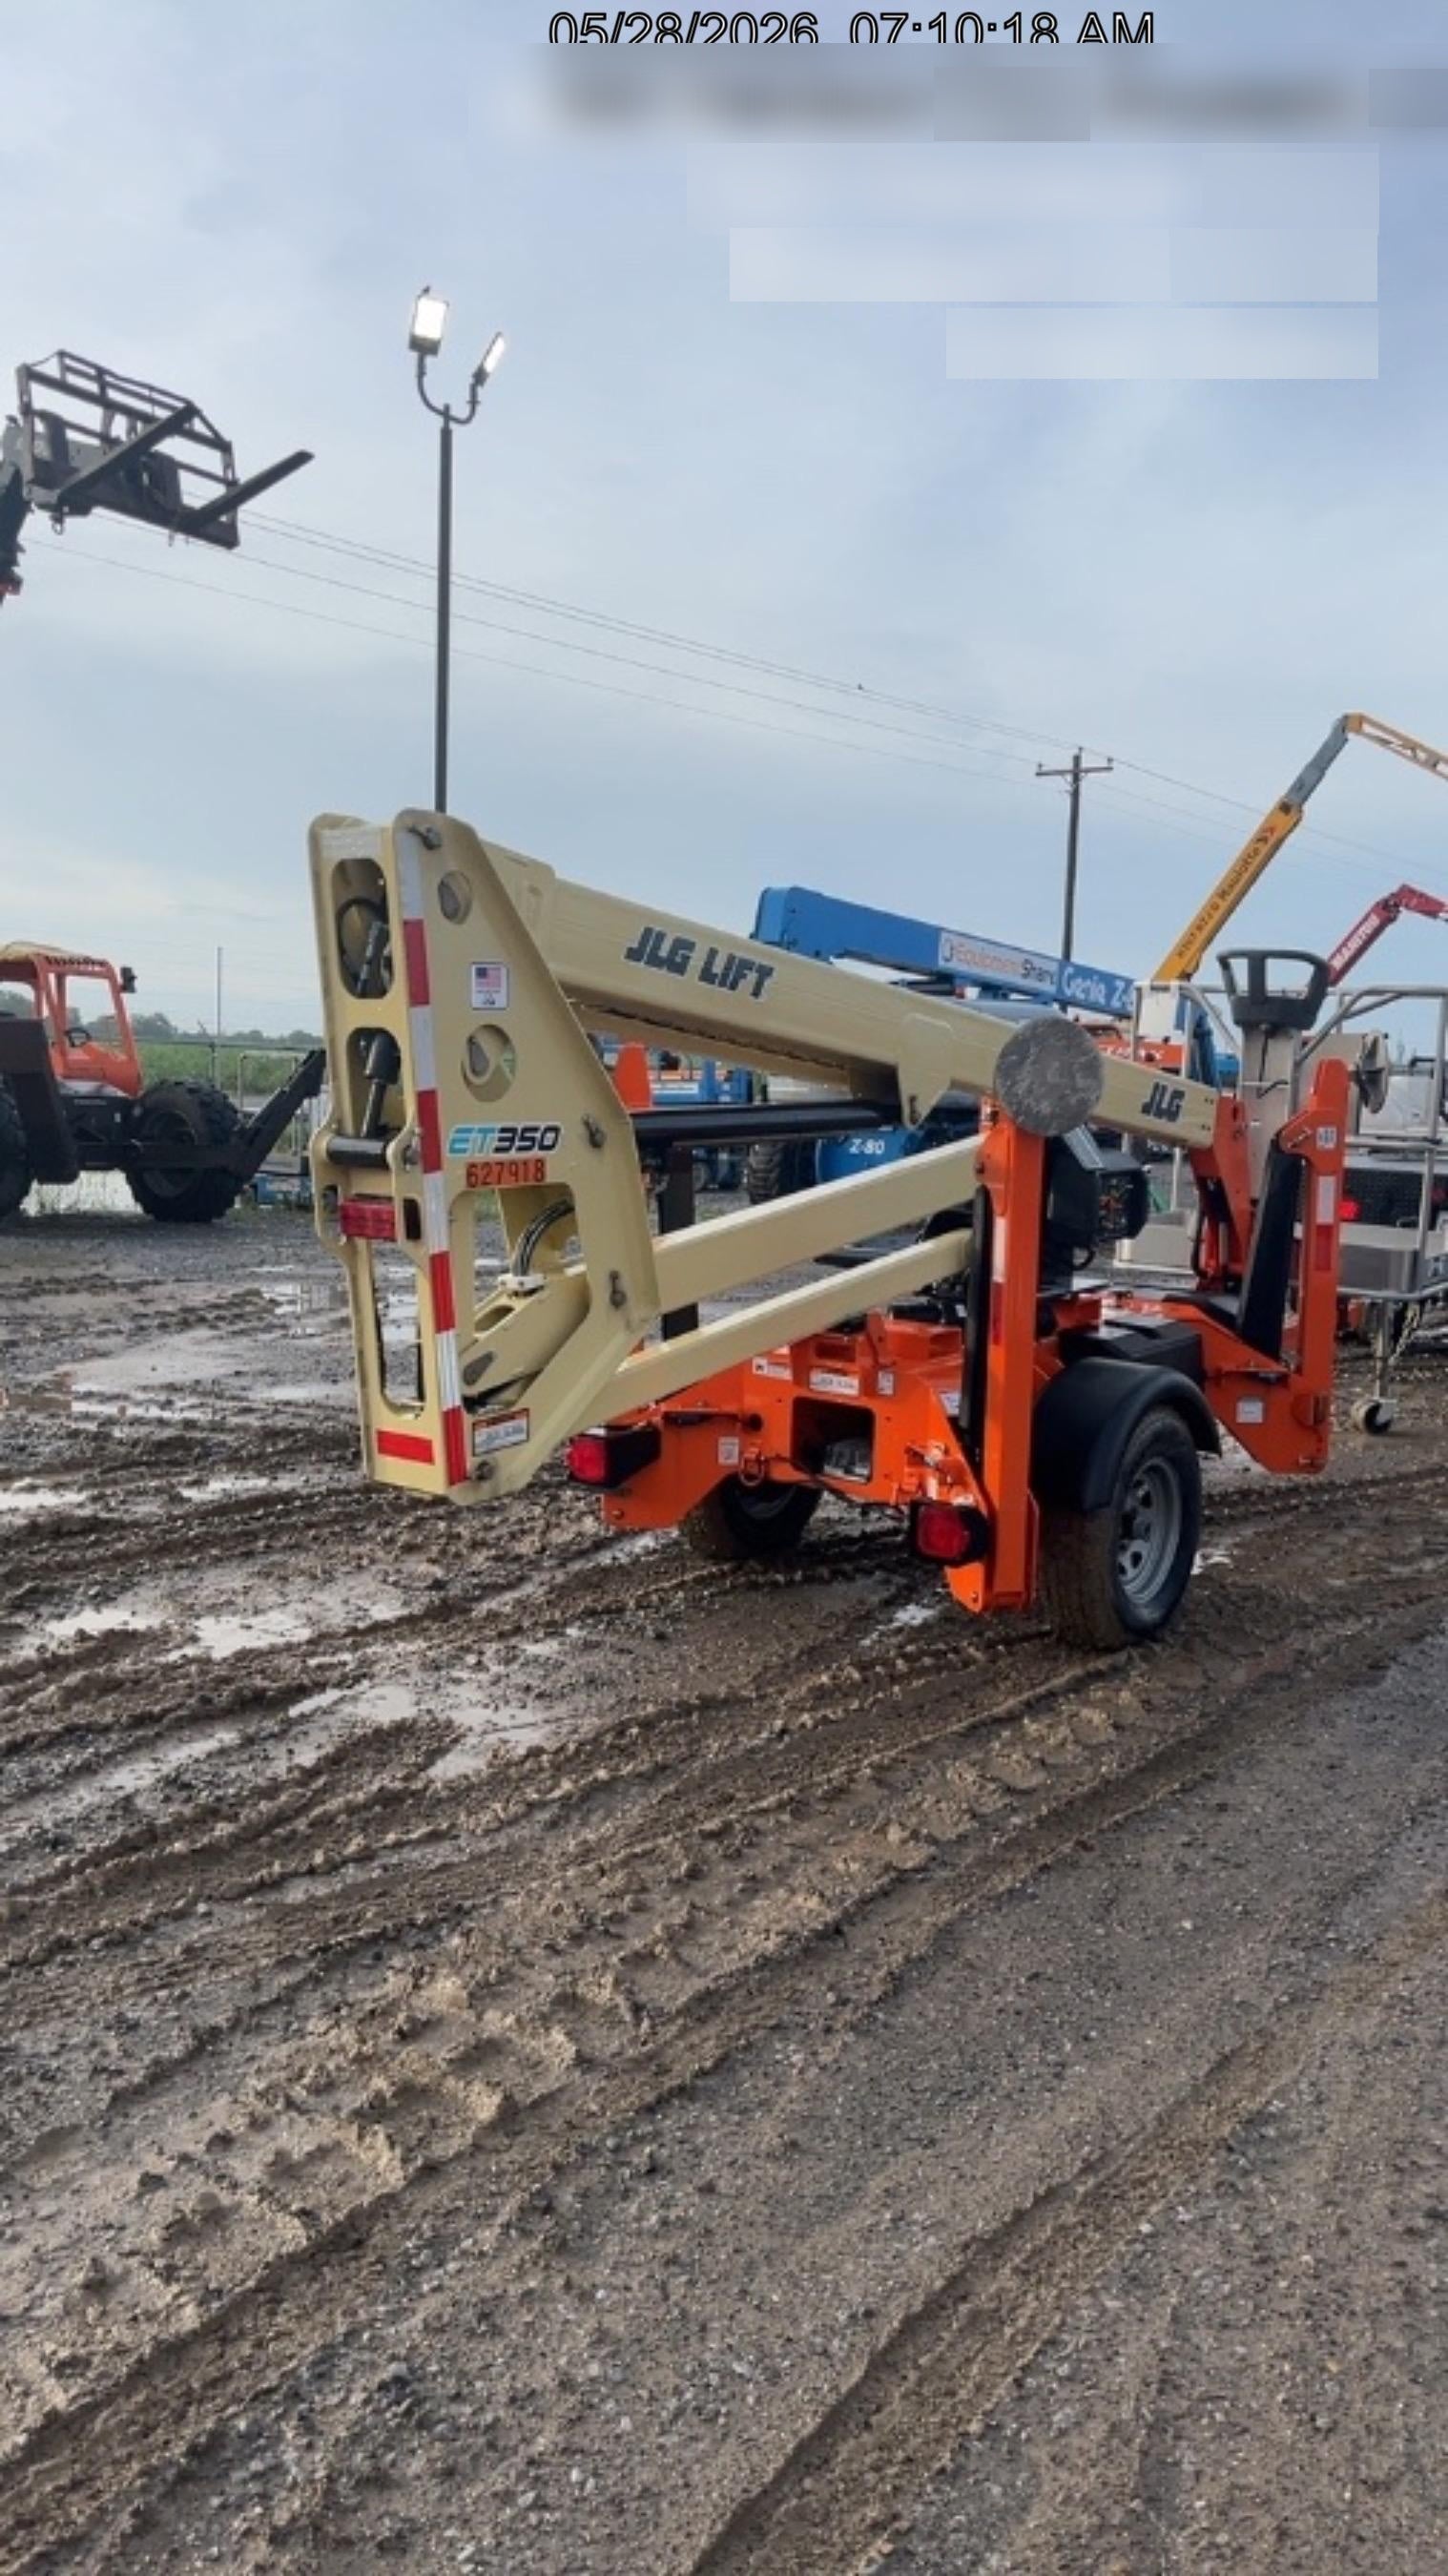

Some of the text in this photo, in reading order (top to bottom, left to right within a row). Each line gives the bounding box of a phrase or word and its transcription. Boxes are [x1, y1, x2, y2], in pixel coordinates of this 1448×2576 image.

[623, 926, 776, 1000] JLG LIFT
[1061, 966, 1106, 1006] Genie
[1141, 1081, 1185, 1123] JLG
[447, 1126, 562, 1154] ET350
[849, 1138, 885, 1154] Z-80
[466, 1158, 545, 1189] 627918
